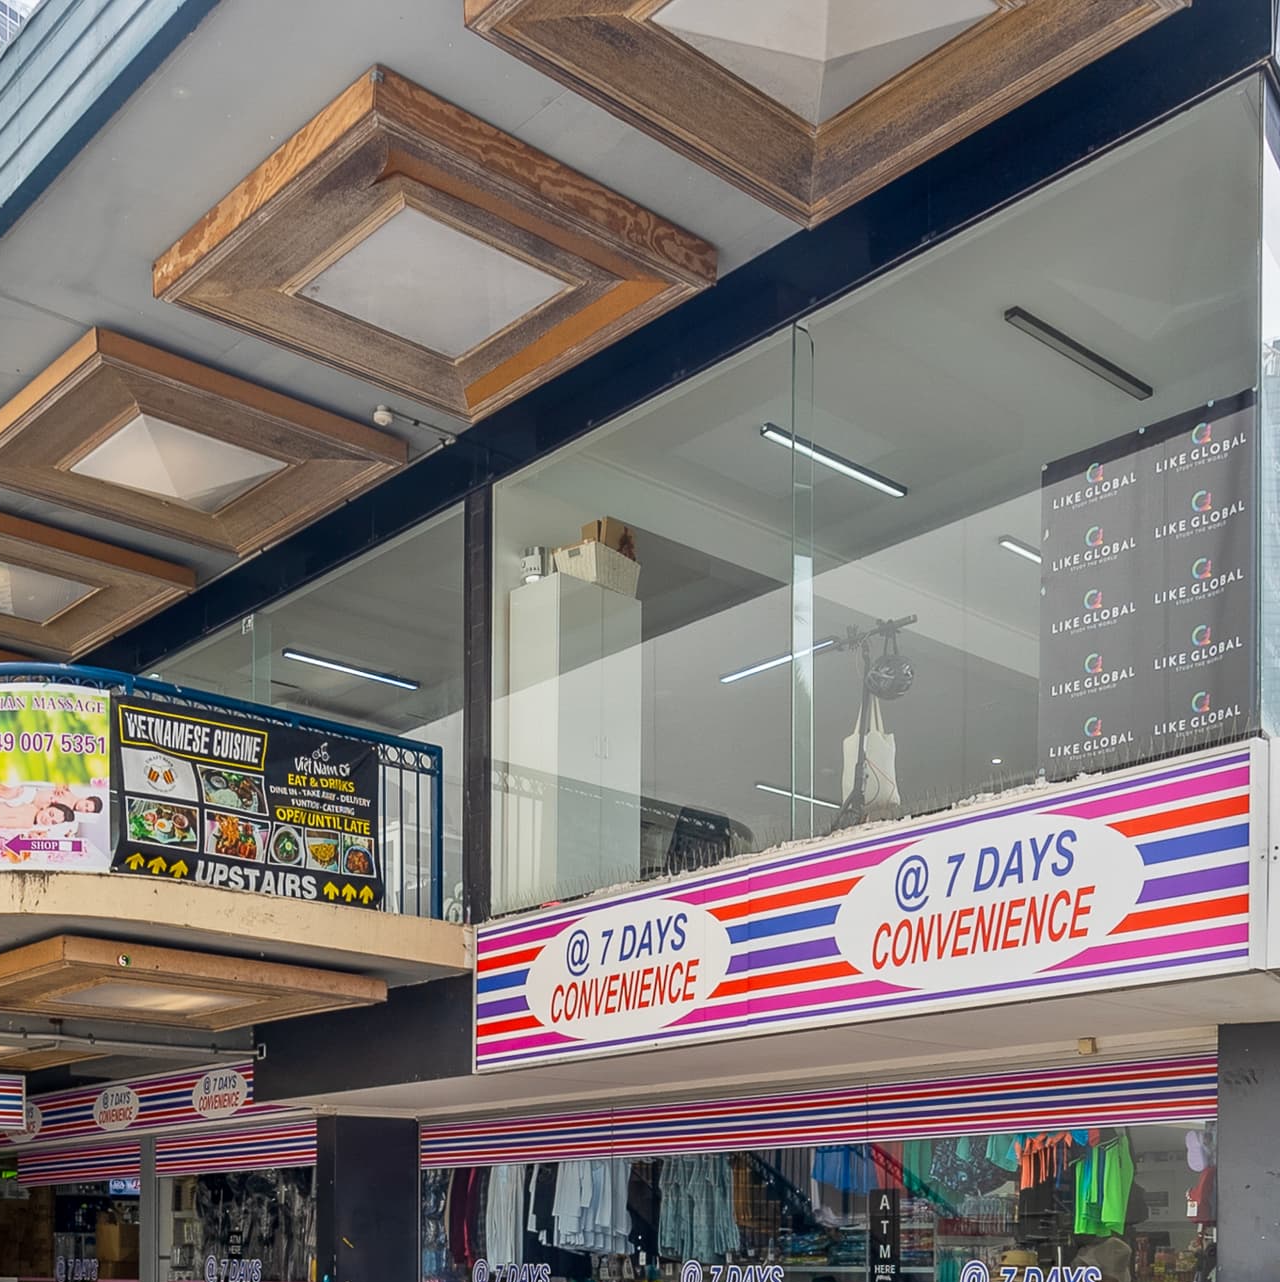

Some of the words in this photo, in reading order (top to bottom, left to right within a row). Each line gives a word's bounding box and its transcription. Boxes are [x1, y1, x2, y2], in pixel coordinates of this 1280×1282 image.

[1156, 453, 1186, 473] LIKE
[1191, 432, 1246, 460] GLOBAL
[1053, 492, 1082, 510] LIKE
[1084, 472, 1136, 498] GLOBAL
[1155, 520, 1186, 538] LIKE
[1191, 500, 1245, 528] GLOBAL
[32, 697, 104, 714] MASSAGE
[20, 733, 54, 752] 007
[61, 734, 105, 754] 5351
[125, 712, 210, 754] VIETNAMESE
[213, 729, 261, 763] CUISINE
[288, 773, 306, 786] EAT
[310, 777, 318, 787] &
[320, 778, 354, 792] DRINKS
[314, 761, 338, 776] Nam
[276, 808, 306, 824] OPEN
[308, 813, 342, 830] UNTIL
[344, 818, 370, 835] LATE
[31, 840, 58, 850] SHOP
[194, 860, 317, 900] UPSTAIRS
[895, 854, 930, 912] @
[946, 852, 966, 898] 7
[972, 829, 1078, 893] DAYS
[566, 929, 590, 976] @
[600, 929, 614, 966] 7
[618, 912, 688, 962] DAYS
[872, 886, 1096, 970] CONVENIENCE
[551, 958, 700, 1024] CONVENIENCE
[879, 1194, 891, 1259] ATM
[874, 1264, 896, 1274] HERE
